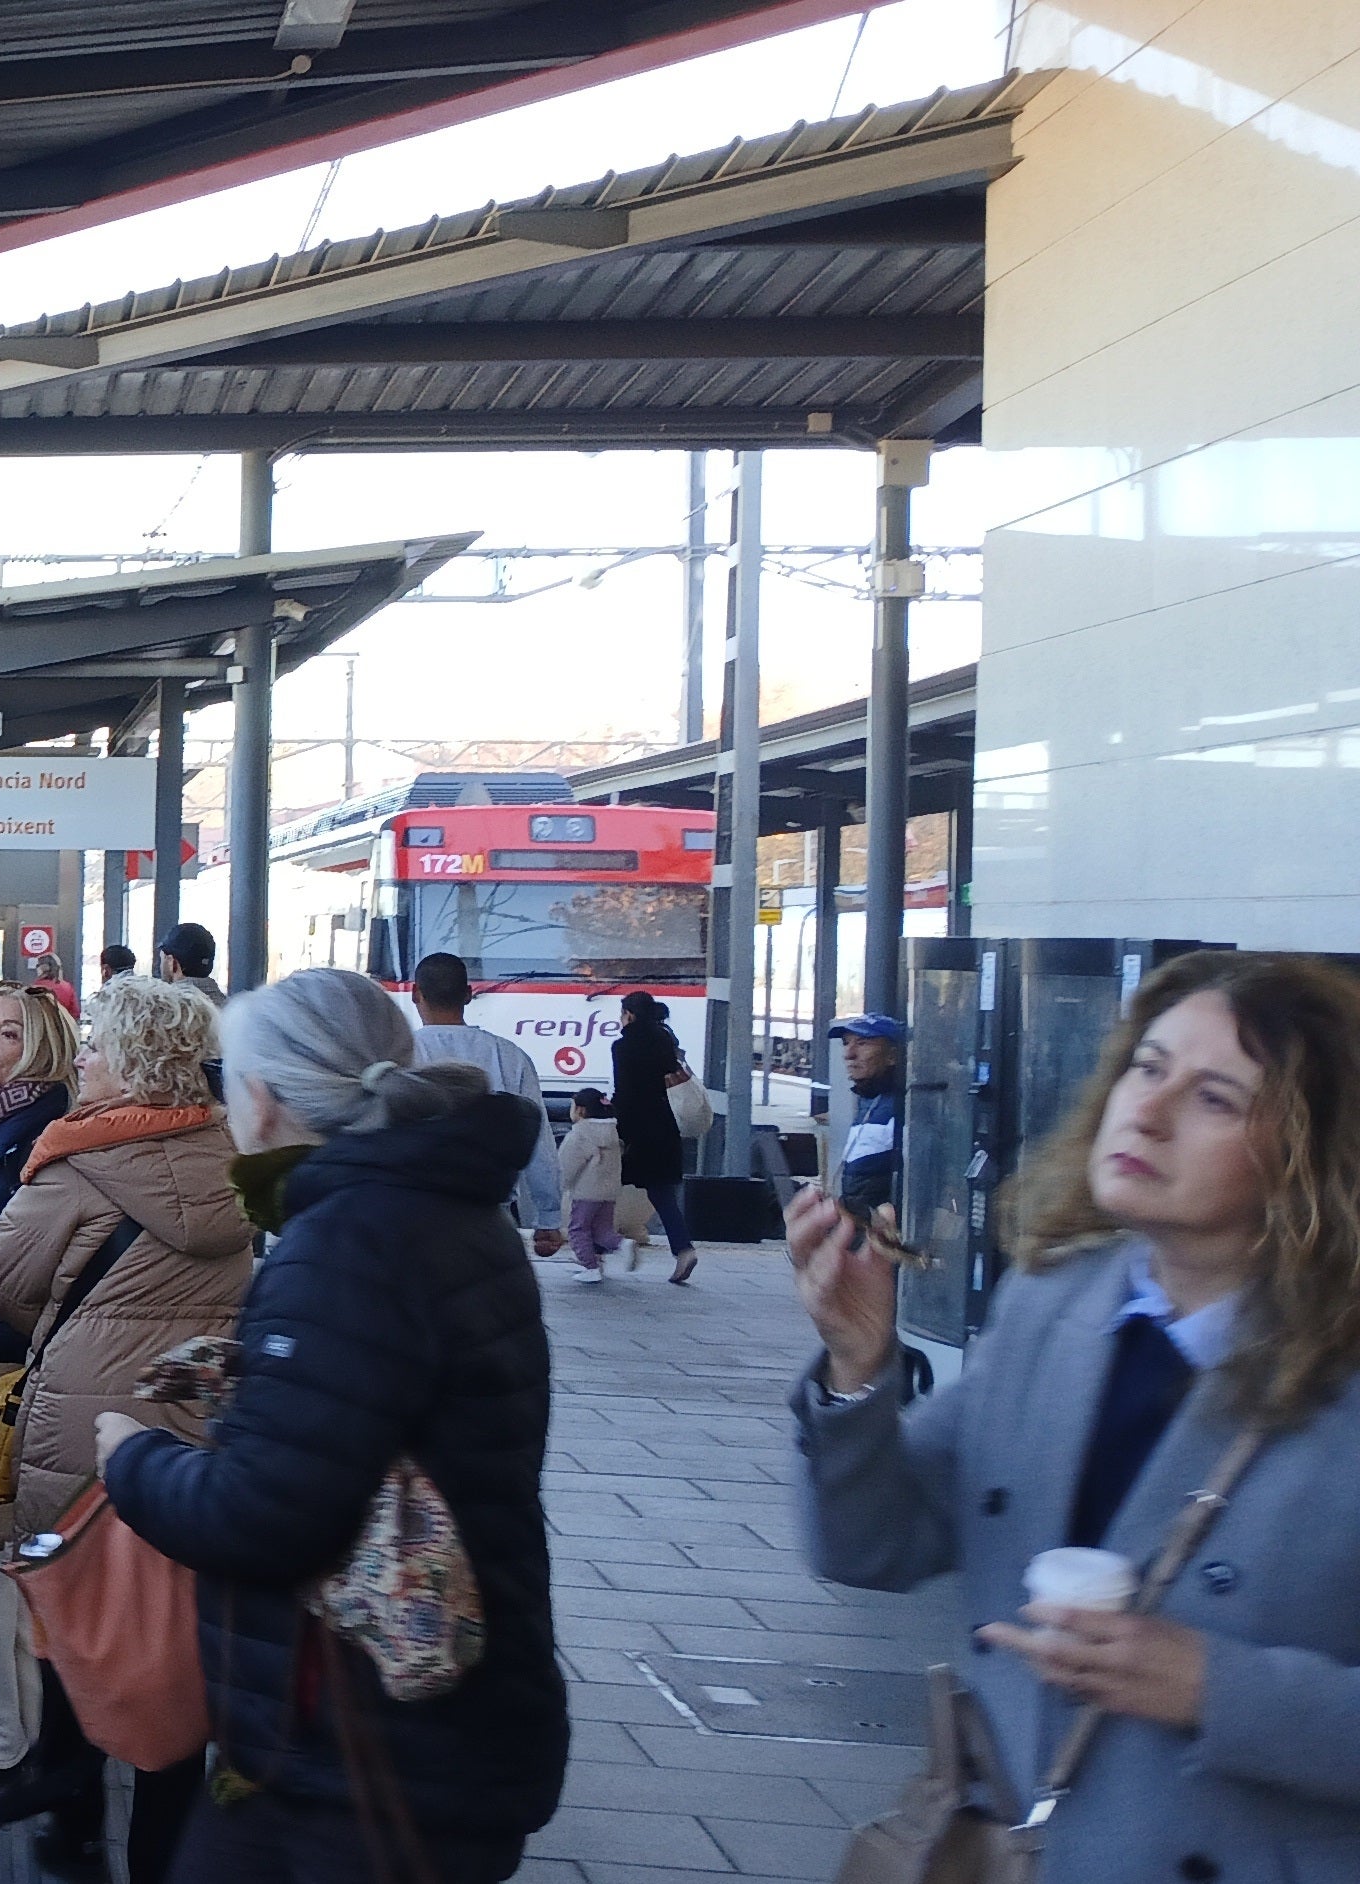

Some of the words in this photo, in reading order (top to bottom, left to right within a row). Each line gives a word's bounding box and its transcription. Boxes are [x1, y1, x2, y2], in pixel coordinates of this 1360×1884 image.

[39, 771, 86, 789] Nord
[419, 853, 484, 874] 172M
[515, 1010, 621, 1047] renfe
